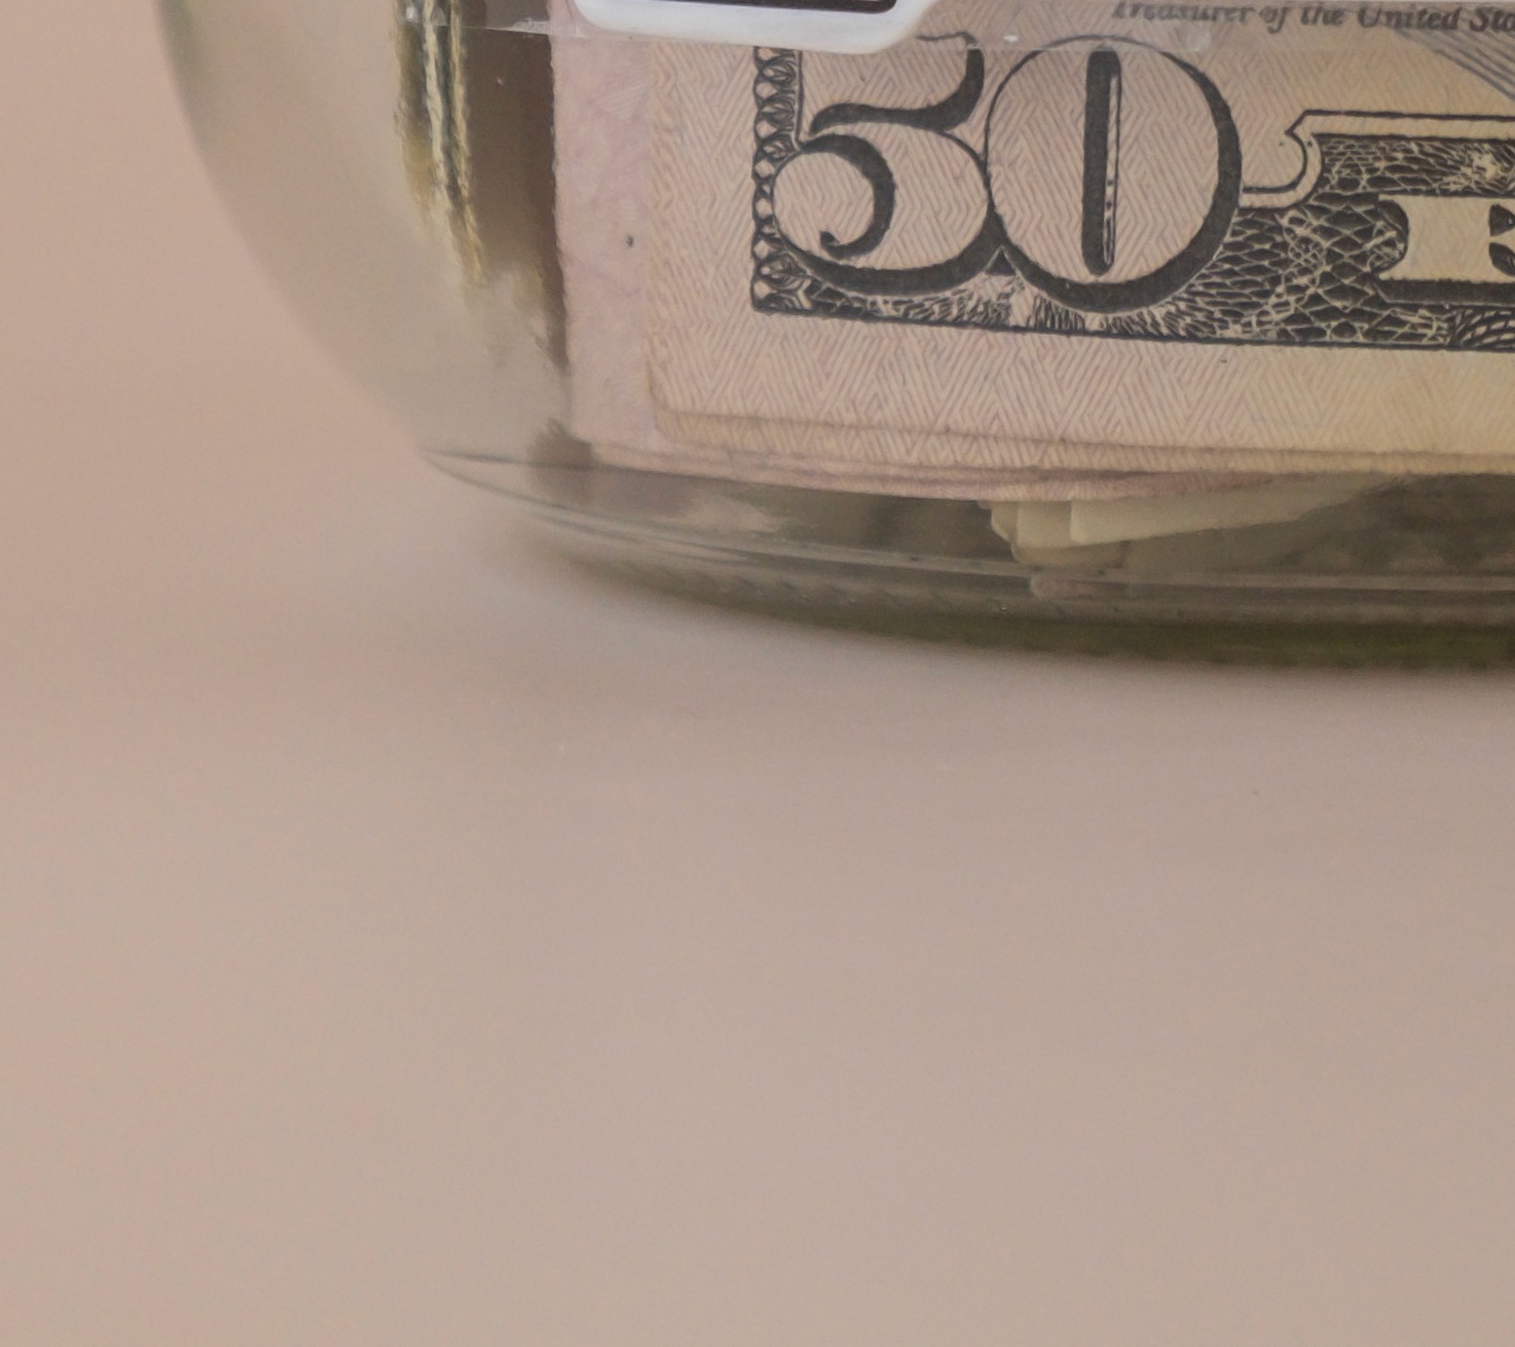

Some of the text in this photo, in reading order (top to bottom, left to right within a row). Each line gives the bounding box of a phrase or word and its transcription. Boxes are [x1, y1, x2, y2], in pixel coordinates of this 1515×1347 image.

[1301, 2, 1345, 25] the
[1358, 3, 1460, 31] United
[772, 31, 1243, 314] 50
